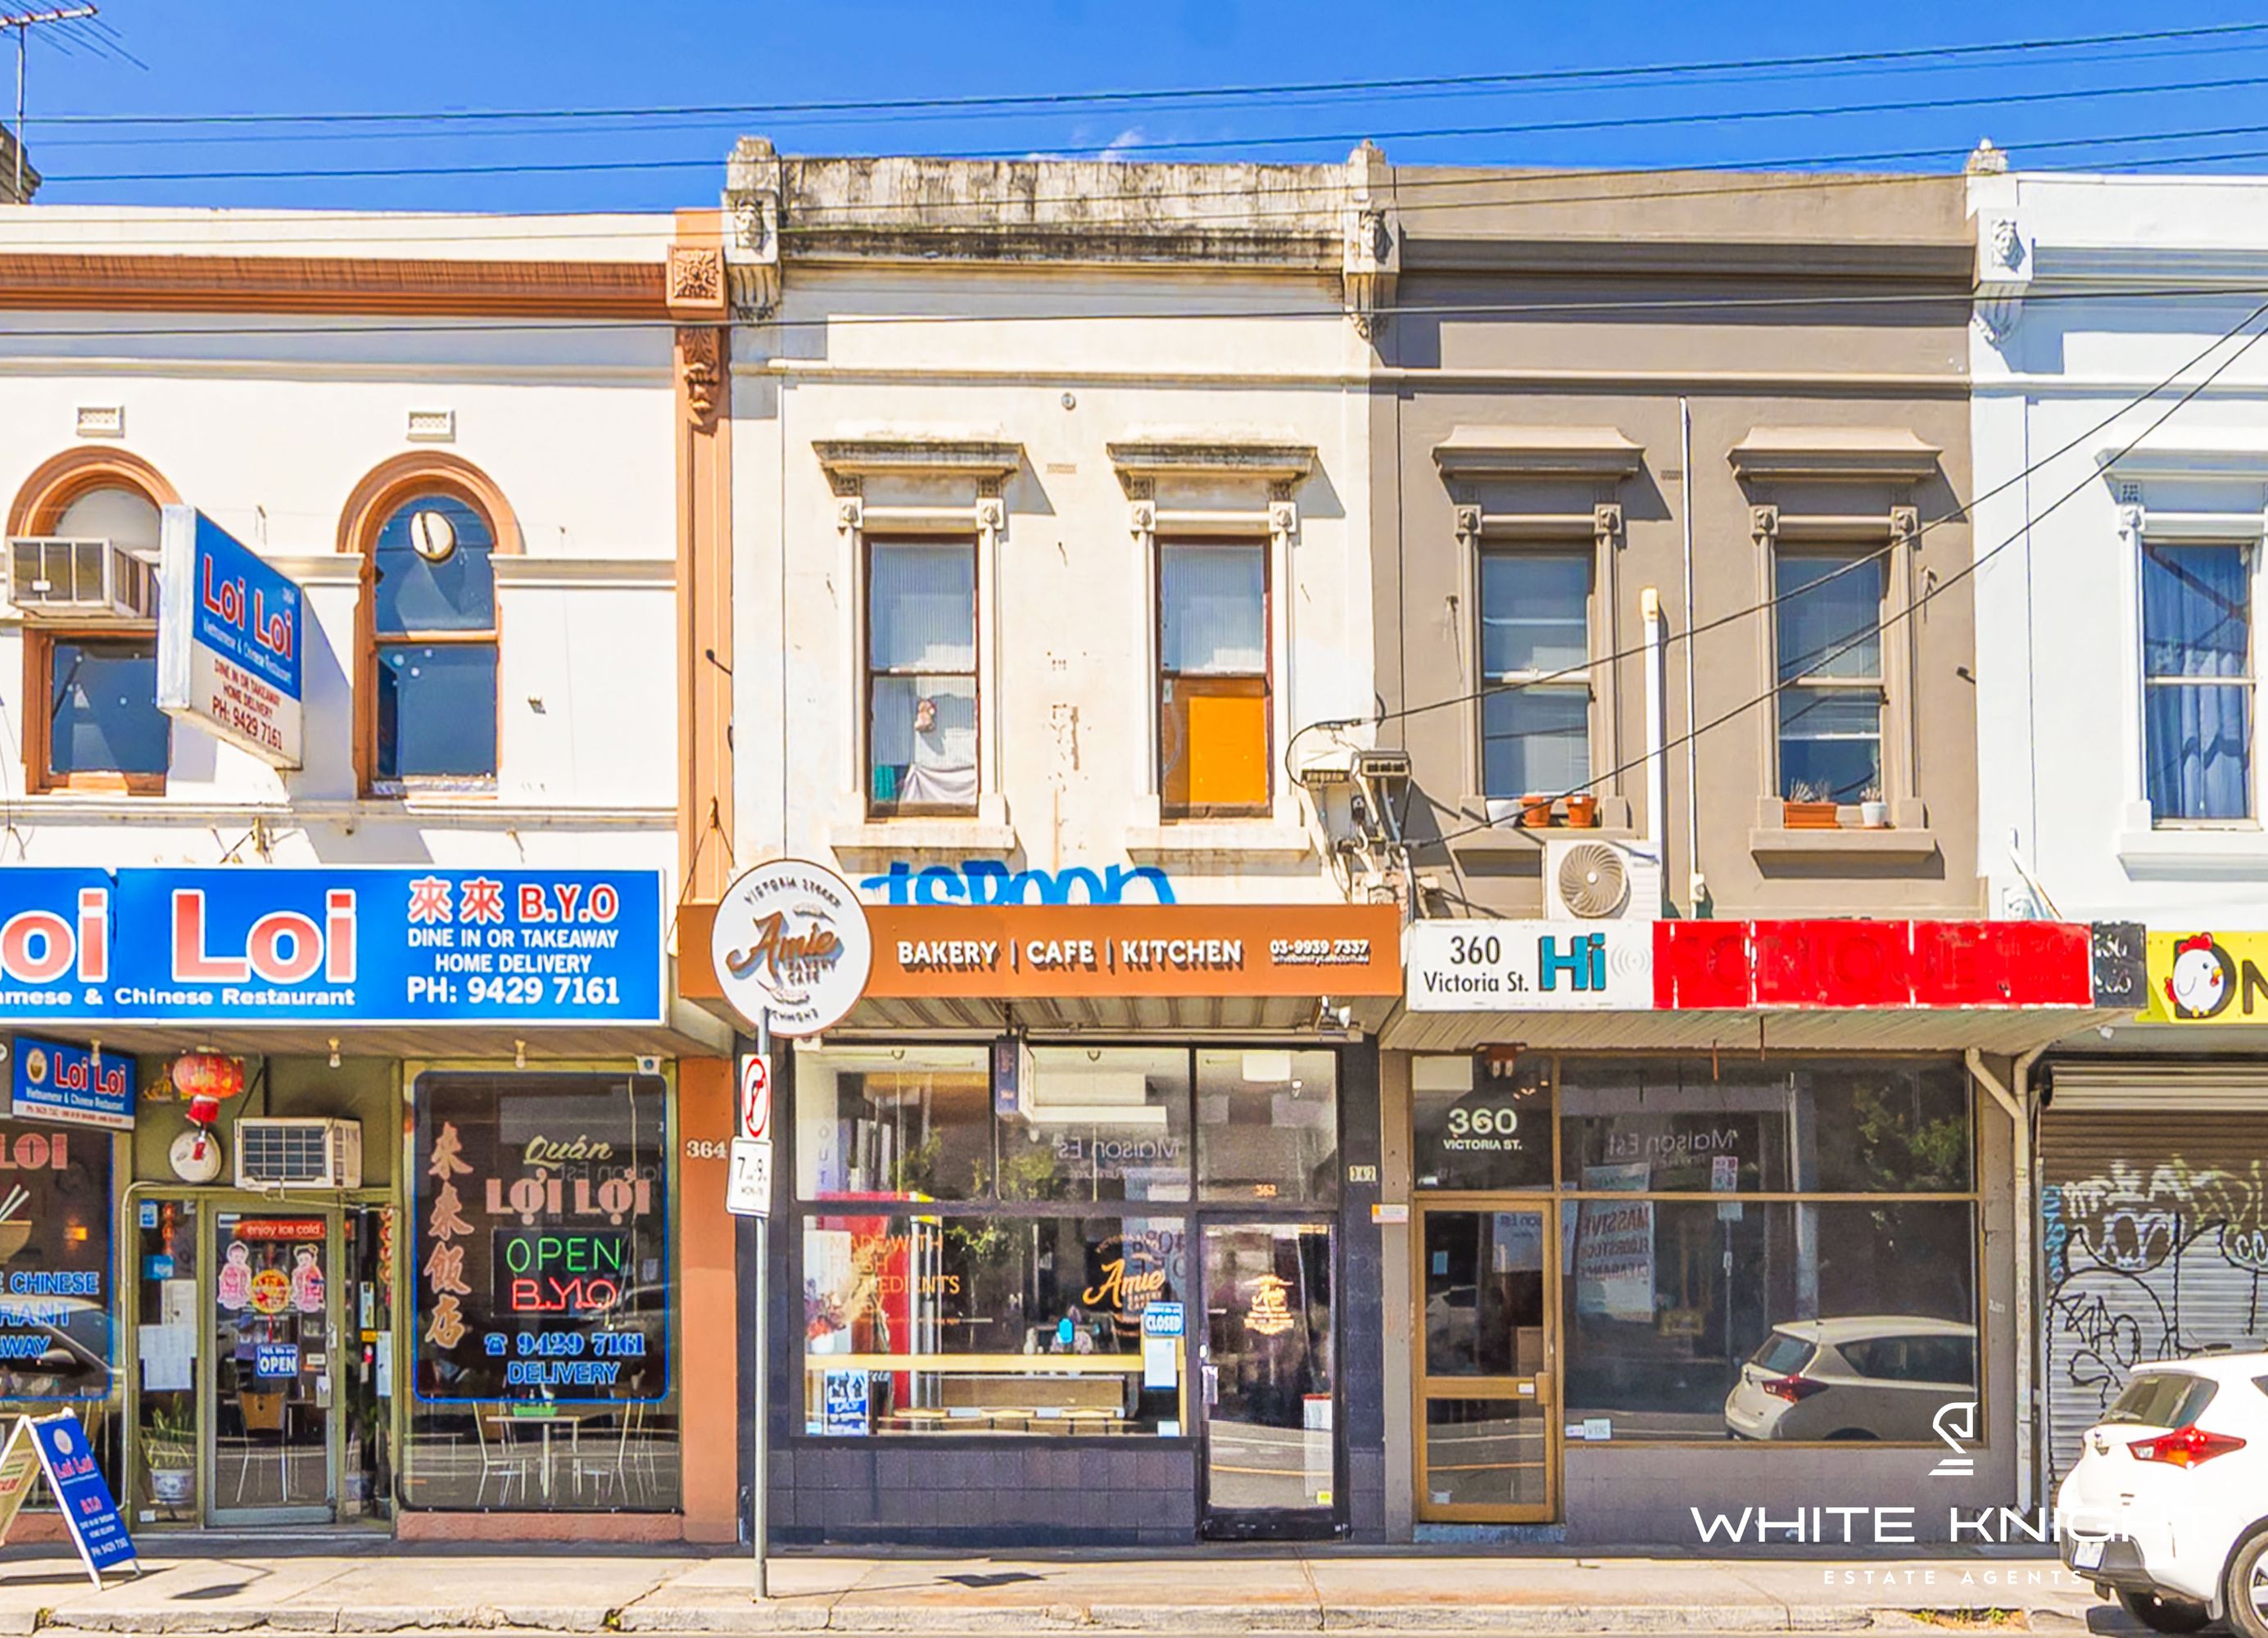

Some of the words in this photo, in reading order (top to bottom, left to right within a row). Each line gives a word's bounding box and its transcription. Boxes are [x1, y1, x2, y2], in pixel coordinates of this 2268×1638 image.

[203, 552, 245, 631] Loi
[255, 587, 292, 662] Loi
[212, 695, 230, 722] PH:
[233, 707, 258, 736] 9429
[261, 721, 283, 750] 7161
[518, 883, 620, 924] B.Y.O
[0, 888, 108, 984] oi
[171, 889, 356, 984] Loi
[408, 928, 455, 948] DINE
[460, 929, 482, 948] IN
[487, 929, 515, 948] OR
[520, 929, 620, 948] TAKEAWAY
[1333, 939, 1370, 955] 7337
[725, 910, 844, 989] Amie
[896, 940, 999, 966] BAKERY
[1025, 940, 1096, 966] CAFE
[1120, 939, 1243, 965] KITCHEN
[1450, 935, 1501, 965] 360
[1538, 932, 1607, 992] Hi
[434, 952, 494, 973] HOME
[498, 953, 593, 974] DELIVERY
[407, 975, 457, 1005] PH:
[467, 975, 544, 1005] 9429
[552, 975, 621, 1005] 7161
[787, 971, 821, 986] CAFE
[1424, 971, 1500, 993] Victoria
[1507, 971, 1529, 993] St.
[0, 990, 73, 1006] mese
[84, 989, 103, 1006] &
[115, 988, 214, 1006] Chinese
[222, 989, 355, 1006] Restaurant
[771, 1007, 820, 1023] CHMOND
[55, 1052, 88, 1091] Loi
[94, 1061, 126, 1097] Loi
[1448, 1107, 1519, 1136] 360
[686, 1139, 727, 1160] 364
[1443, 1139, 1502, 1151] VICTORIA
[1504, 1139, 1523, 1151] ST.
[247, 1224, 277, 1238] enjoy
[278, 1225, 294, 1235] ice
[297, 1224, 320, 1235] cold
[890, 1233, 944, 1252] WTH
[506, 1237, 621, 1273] OPEN
[10, 1271, 100, 1295] CHINESE
[1082, 1258, 1166, 1308] Amie
[1144, 1314, 1182, 1333] CLOSED
[0, 1335, 52, 1360] WAY
[516, 1332, 585, 1356] 9429
[591, 1332, 646, 1357] 7161
[259, 1355, 298, 1373] OPEN
[507, 1360, 621, 1385] DELIVERY
